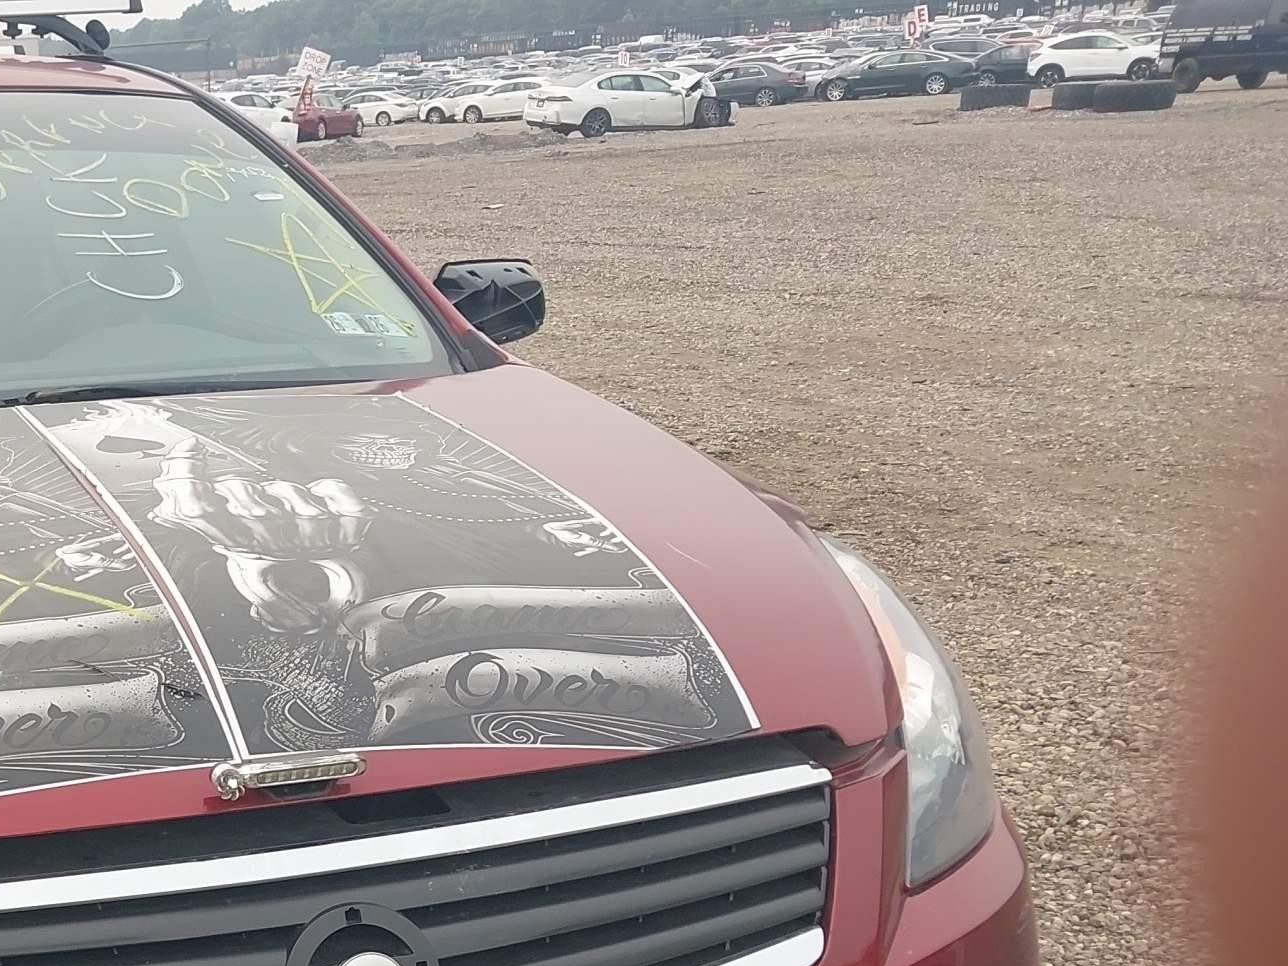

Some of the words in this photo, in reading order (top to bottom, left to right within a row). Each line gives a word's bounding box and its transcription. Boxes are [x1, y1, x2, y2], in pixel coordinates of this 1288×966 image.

[917, 8, 927, 24] E
[907, 20, 917, 37] D
[304, 51, 328, 65] DROP
[440, 651, 654, 715] Over
